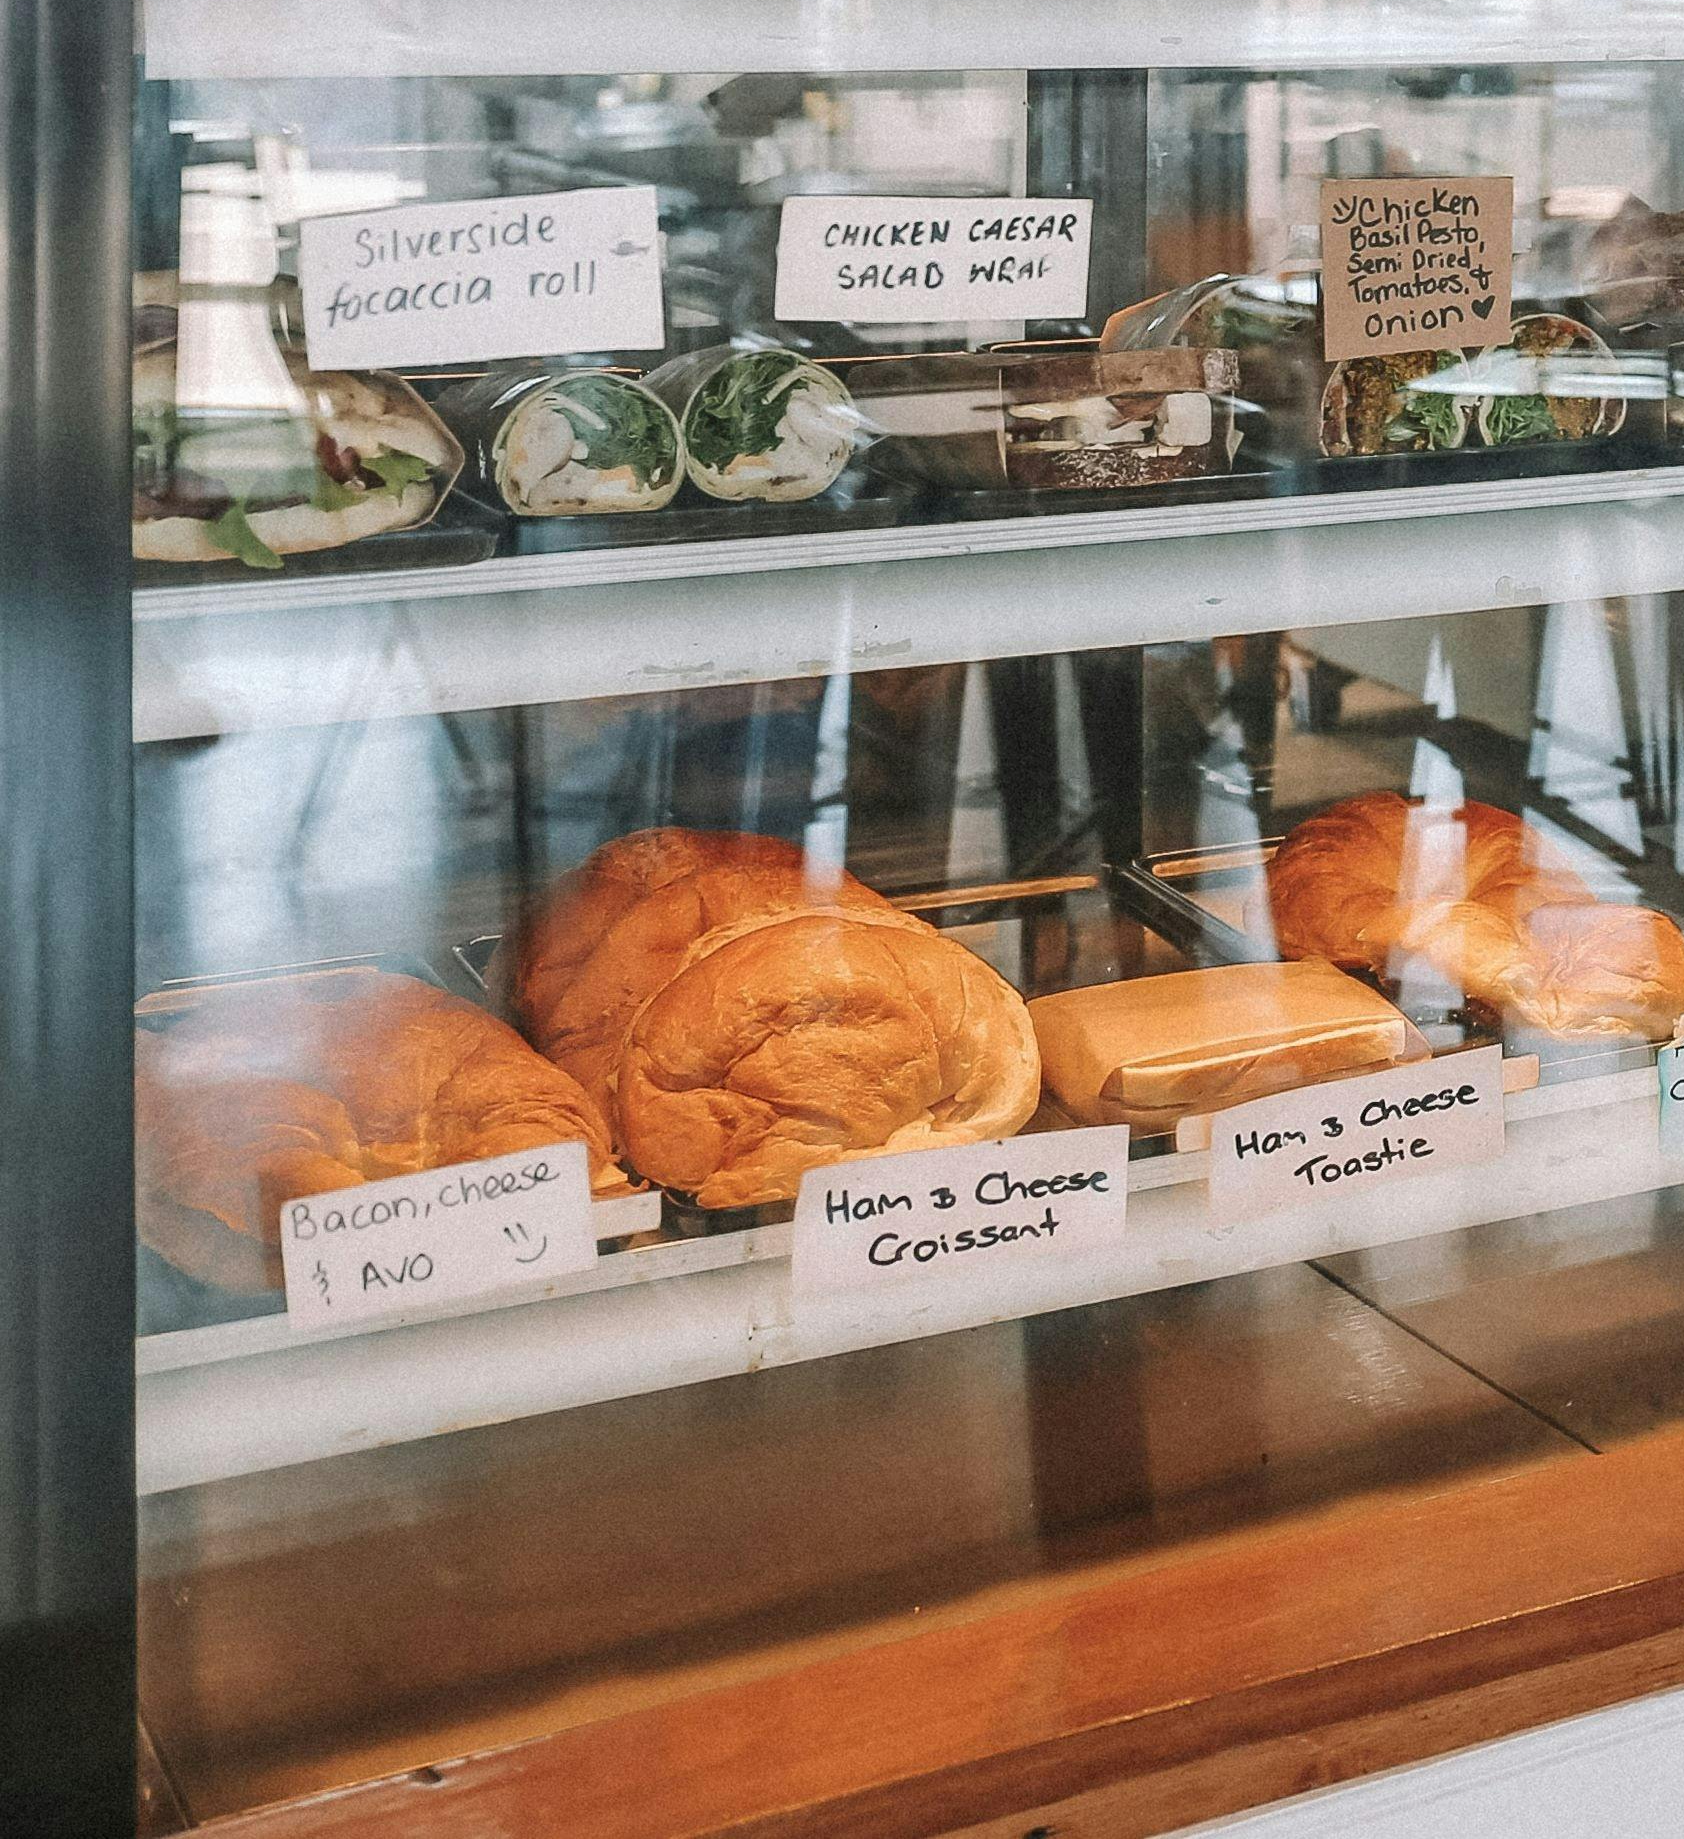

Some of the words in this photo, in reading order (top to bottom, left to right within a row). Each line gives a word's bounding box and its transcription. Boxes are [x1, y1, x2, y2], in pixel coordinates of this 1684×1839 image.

[824, 220, 950, 248] CHICKEN
[969, 214, 1078, 242] CAESAR
[1359, 188, 1480, 228] Chicken
[355, 212, 556, 269] Silverside
[1347, 252, 1402, 274] Semi
[1413, 246, 1471, 270] Dried
[1350, 225, 1409, 252] Basil
[326, 271, 493, 328] focaccia
[529, 260, 596, 298] roll
[839, 262, 944, 290] SALAD
[1235, 1130, 1306, 1159] Ham
[1359, 1084, 1479, 1127] Cheese
[1294, 1136, 1435, 1185] Toastie
[291, 1195, 431, 1241] Bacon,
[826, 1189, 912, 1224] Ham
[975, 1170, 1110, 1205] Cheese
[868, 1207, 1060, 1266] Croissant
